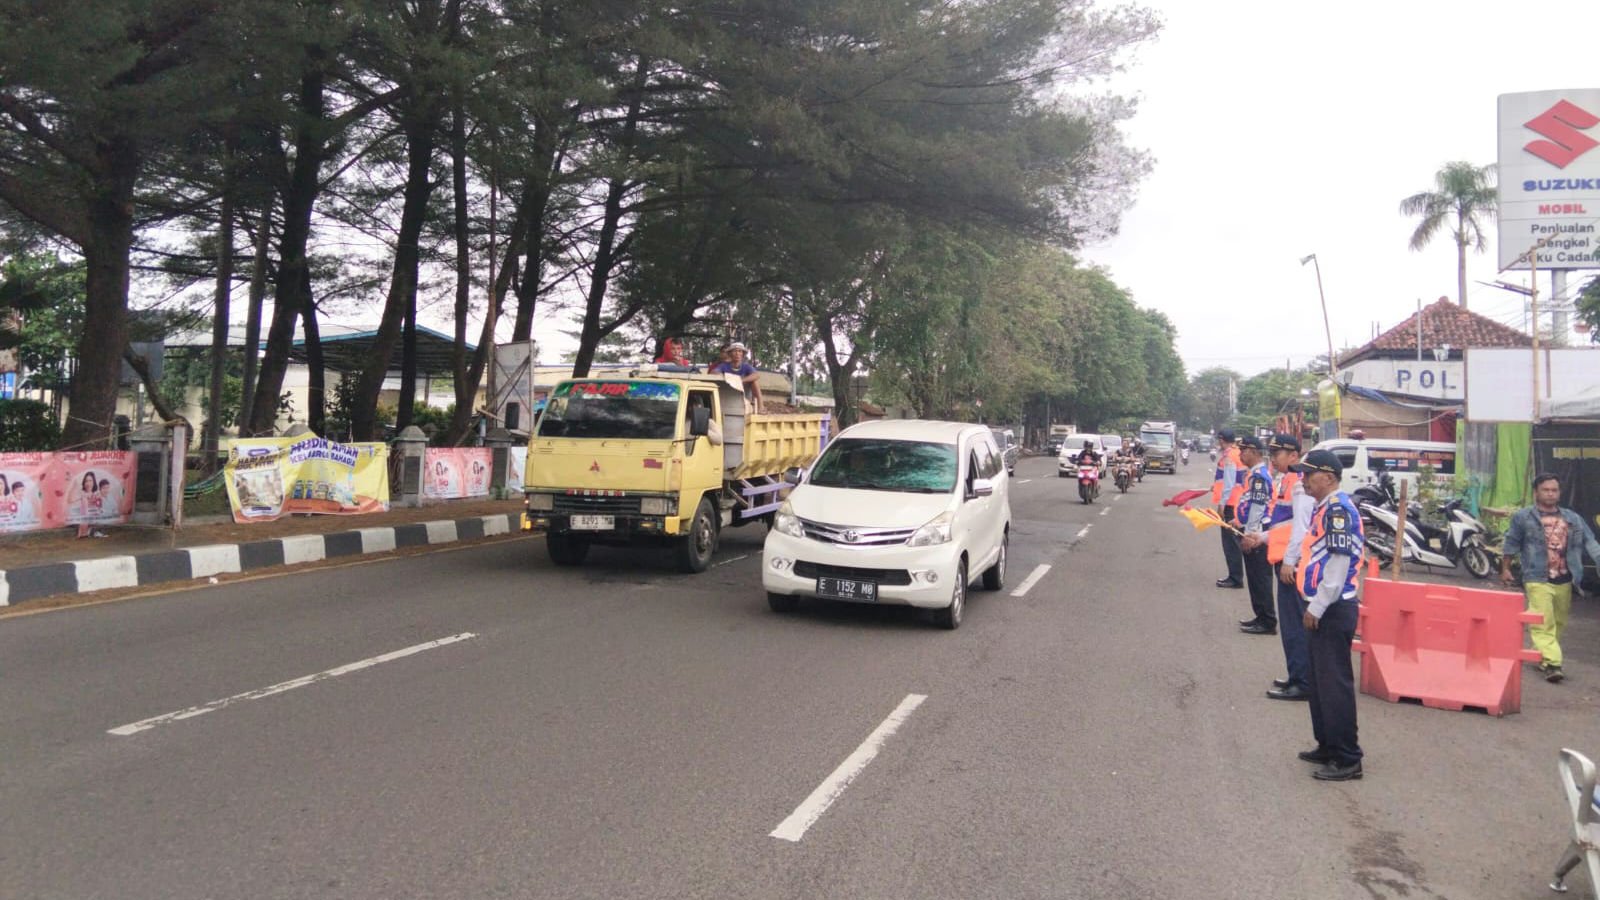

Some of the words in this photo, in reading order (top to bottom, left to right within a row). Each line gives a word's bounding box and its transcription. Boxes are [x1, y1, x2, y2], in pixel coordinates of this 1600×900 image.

[1538, 203, 1587, 215] MOBIL
[820, 579, 826, 589] E
[837, 581, 856, 593] 1152
